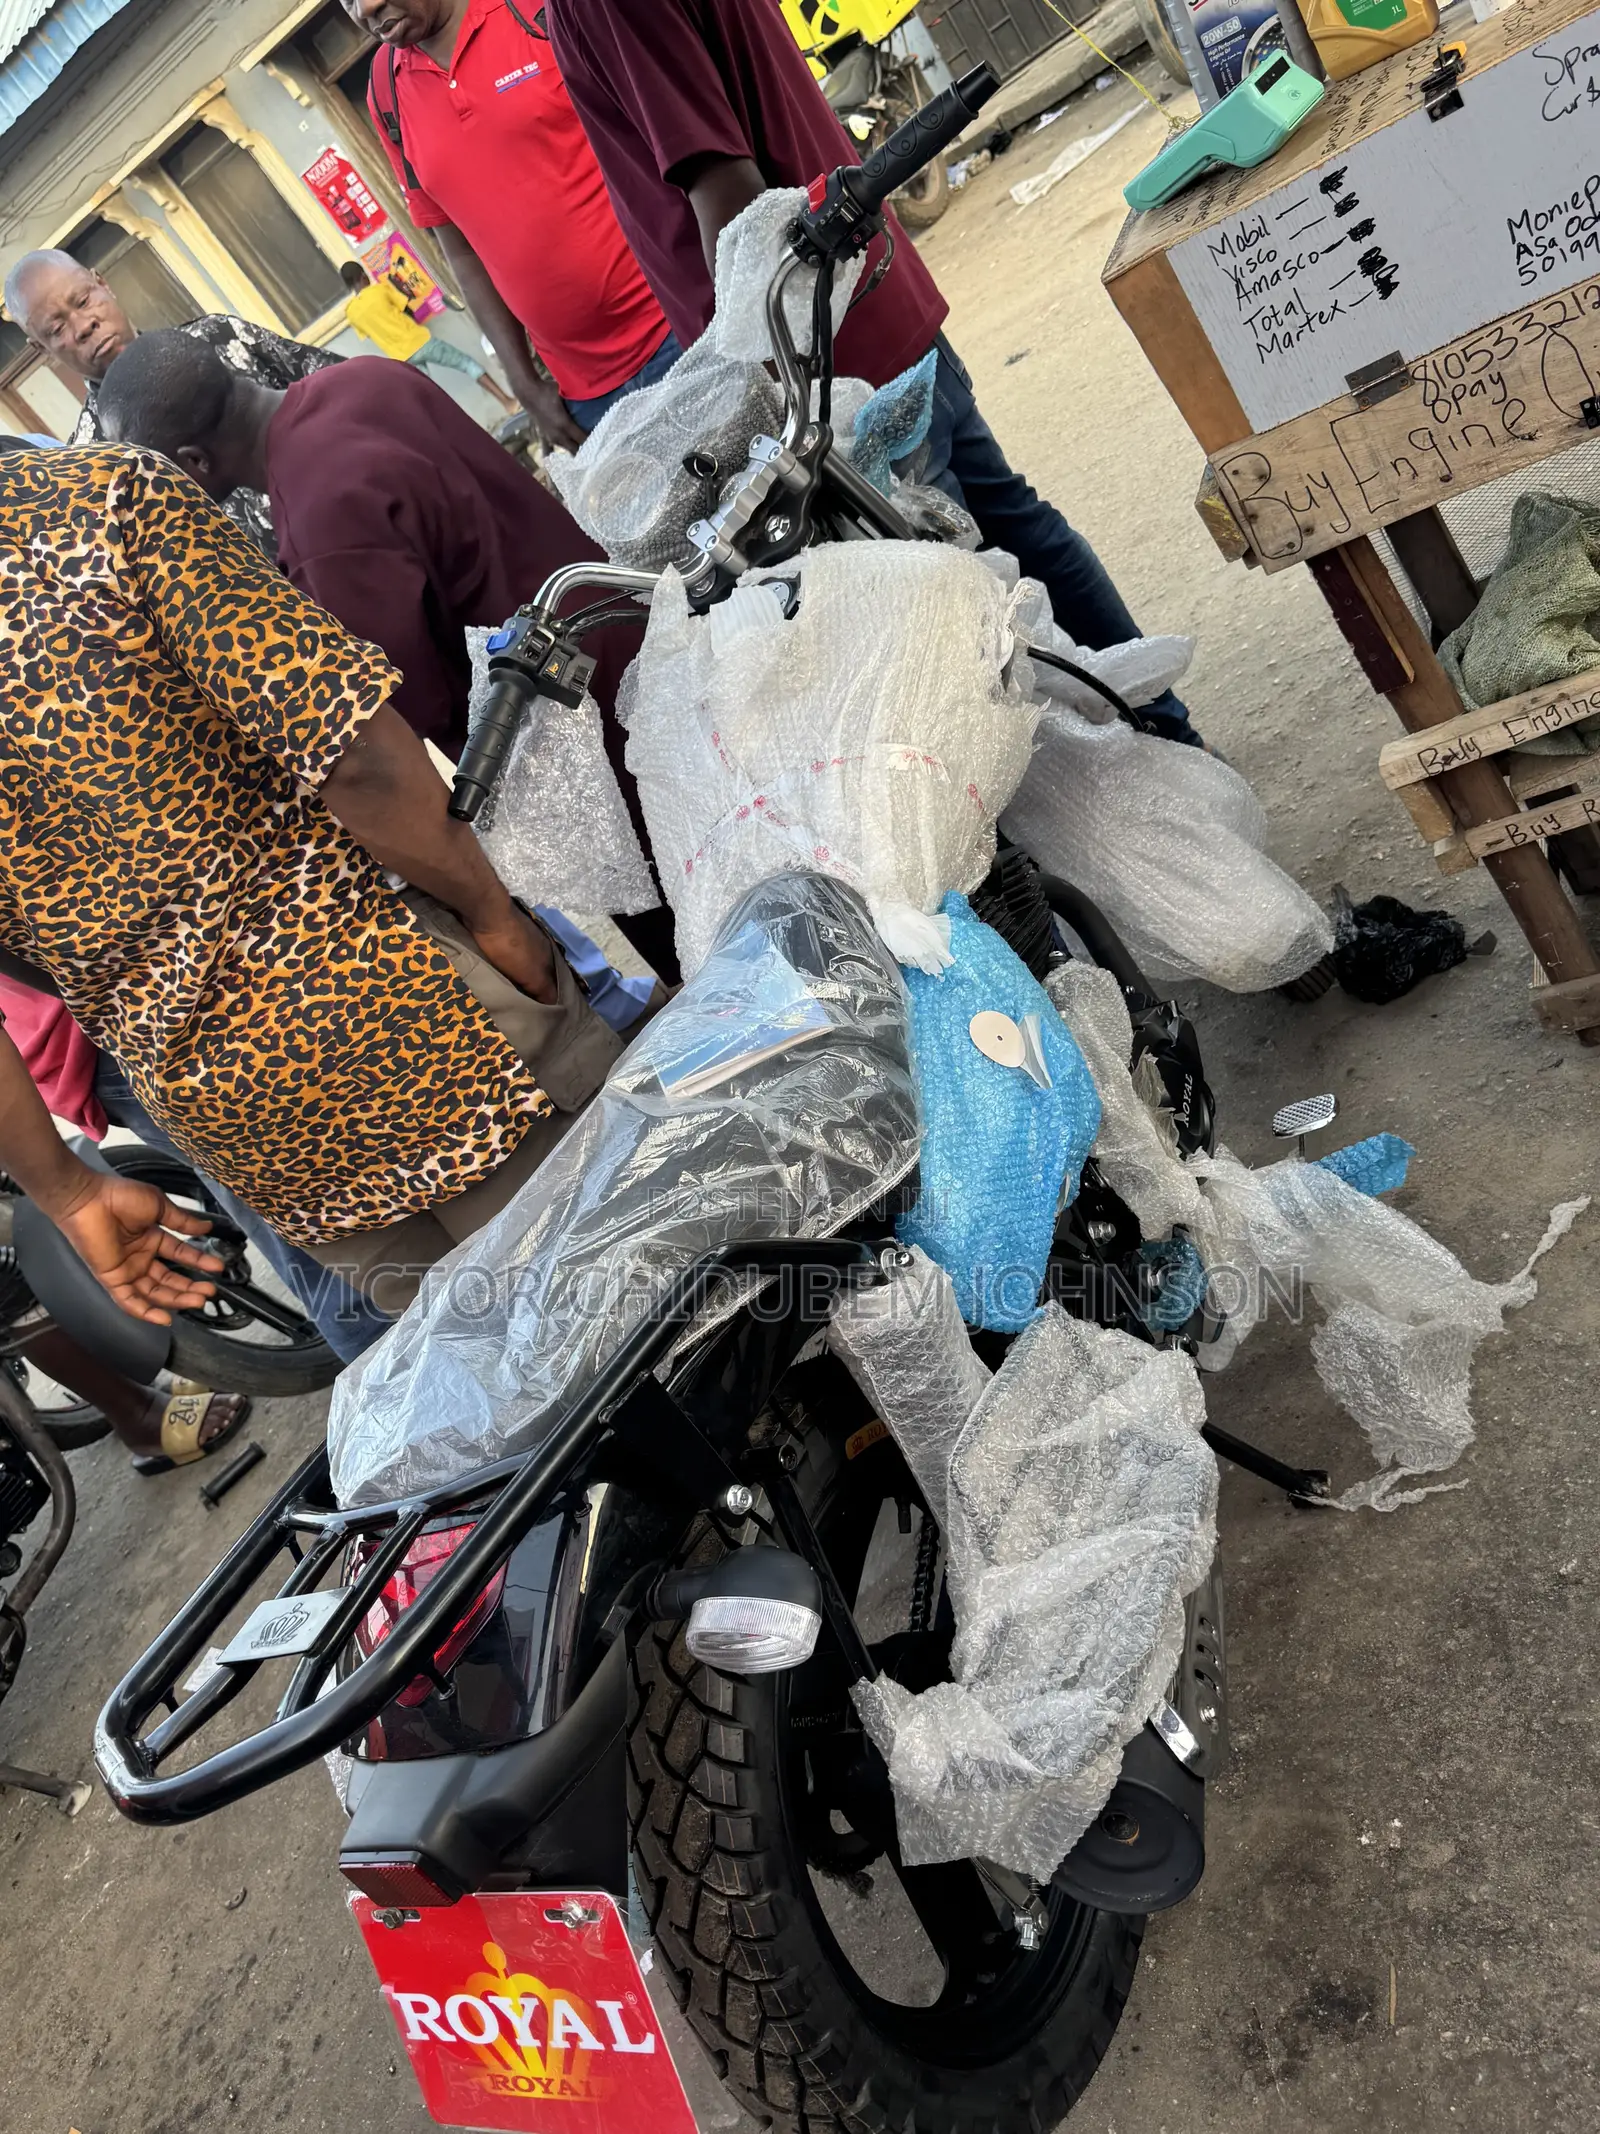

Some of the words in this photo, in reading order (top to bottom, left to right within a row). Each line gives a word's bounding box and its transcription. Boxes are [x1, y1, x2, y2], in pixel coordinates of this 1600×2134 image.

[1202, 19, 1240, 46] 20W-50
[1217, 33, 1246, 52] Performance
[1242, 287, 1311, 340] Total
[1255, 298, 1347, 365] Martex
[1218, 451, 1352, 560] Buy
[1330, 397, 1530, 515] Engine
[391, 1992, 656, 2055] ROYAL
[486, 2072, 604, 2100] ROYAL
